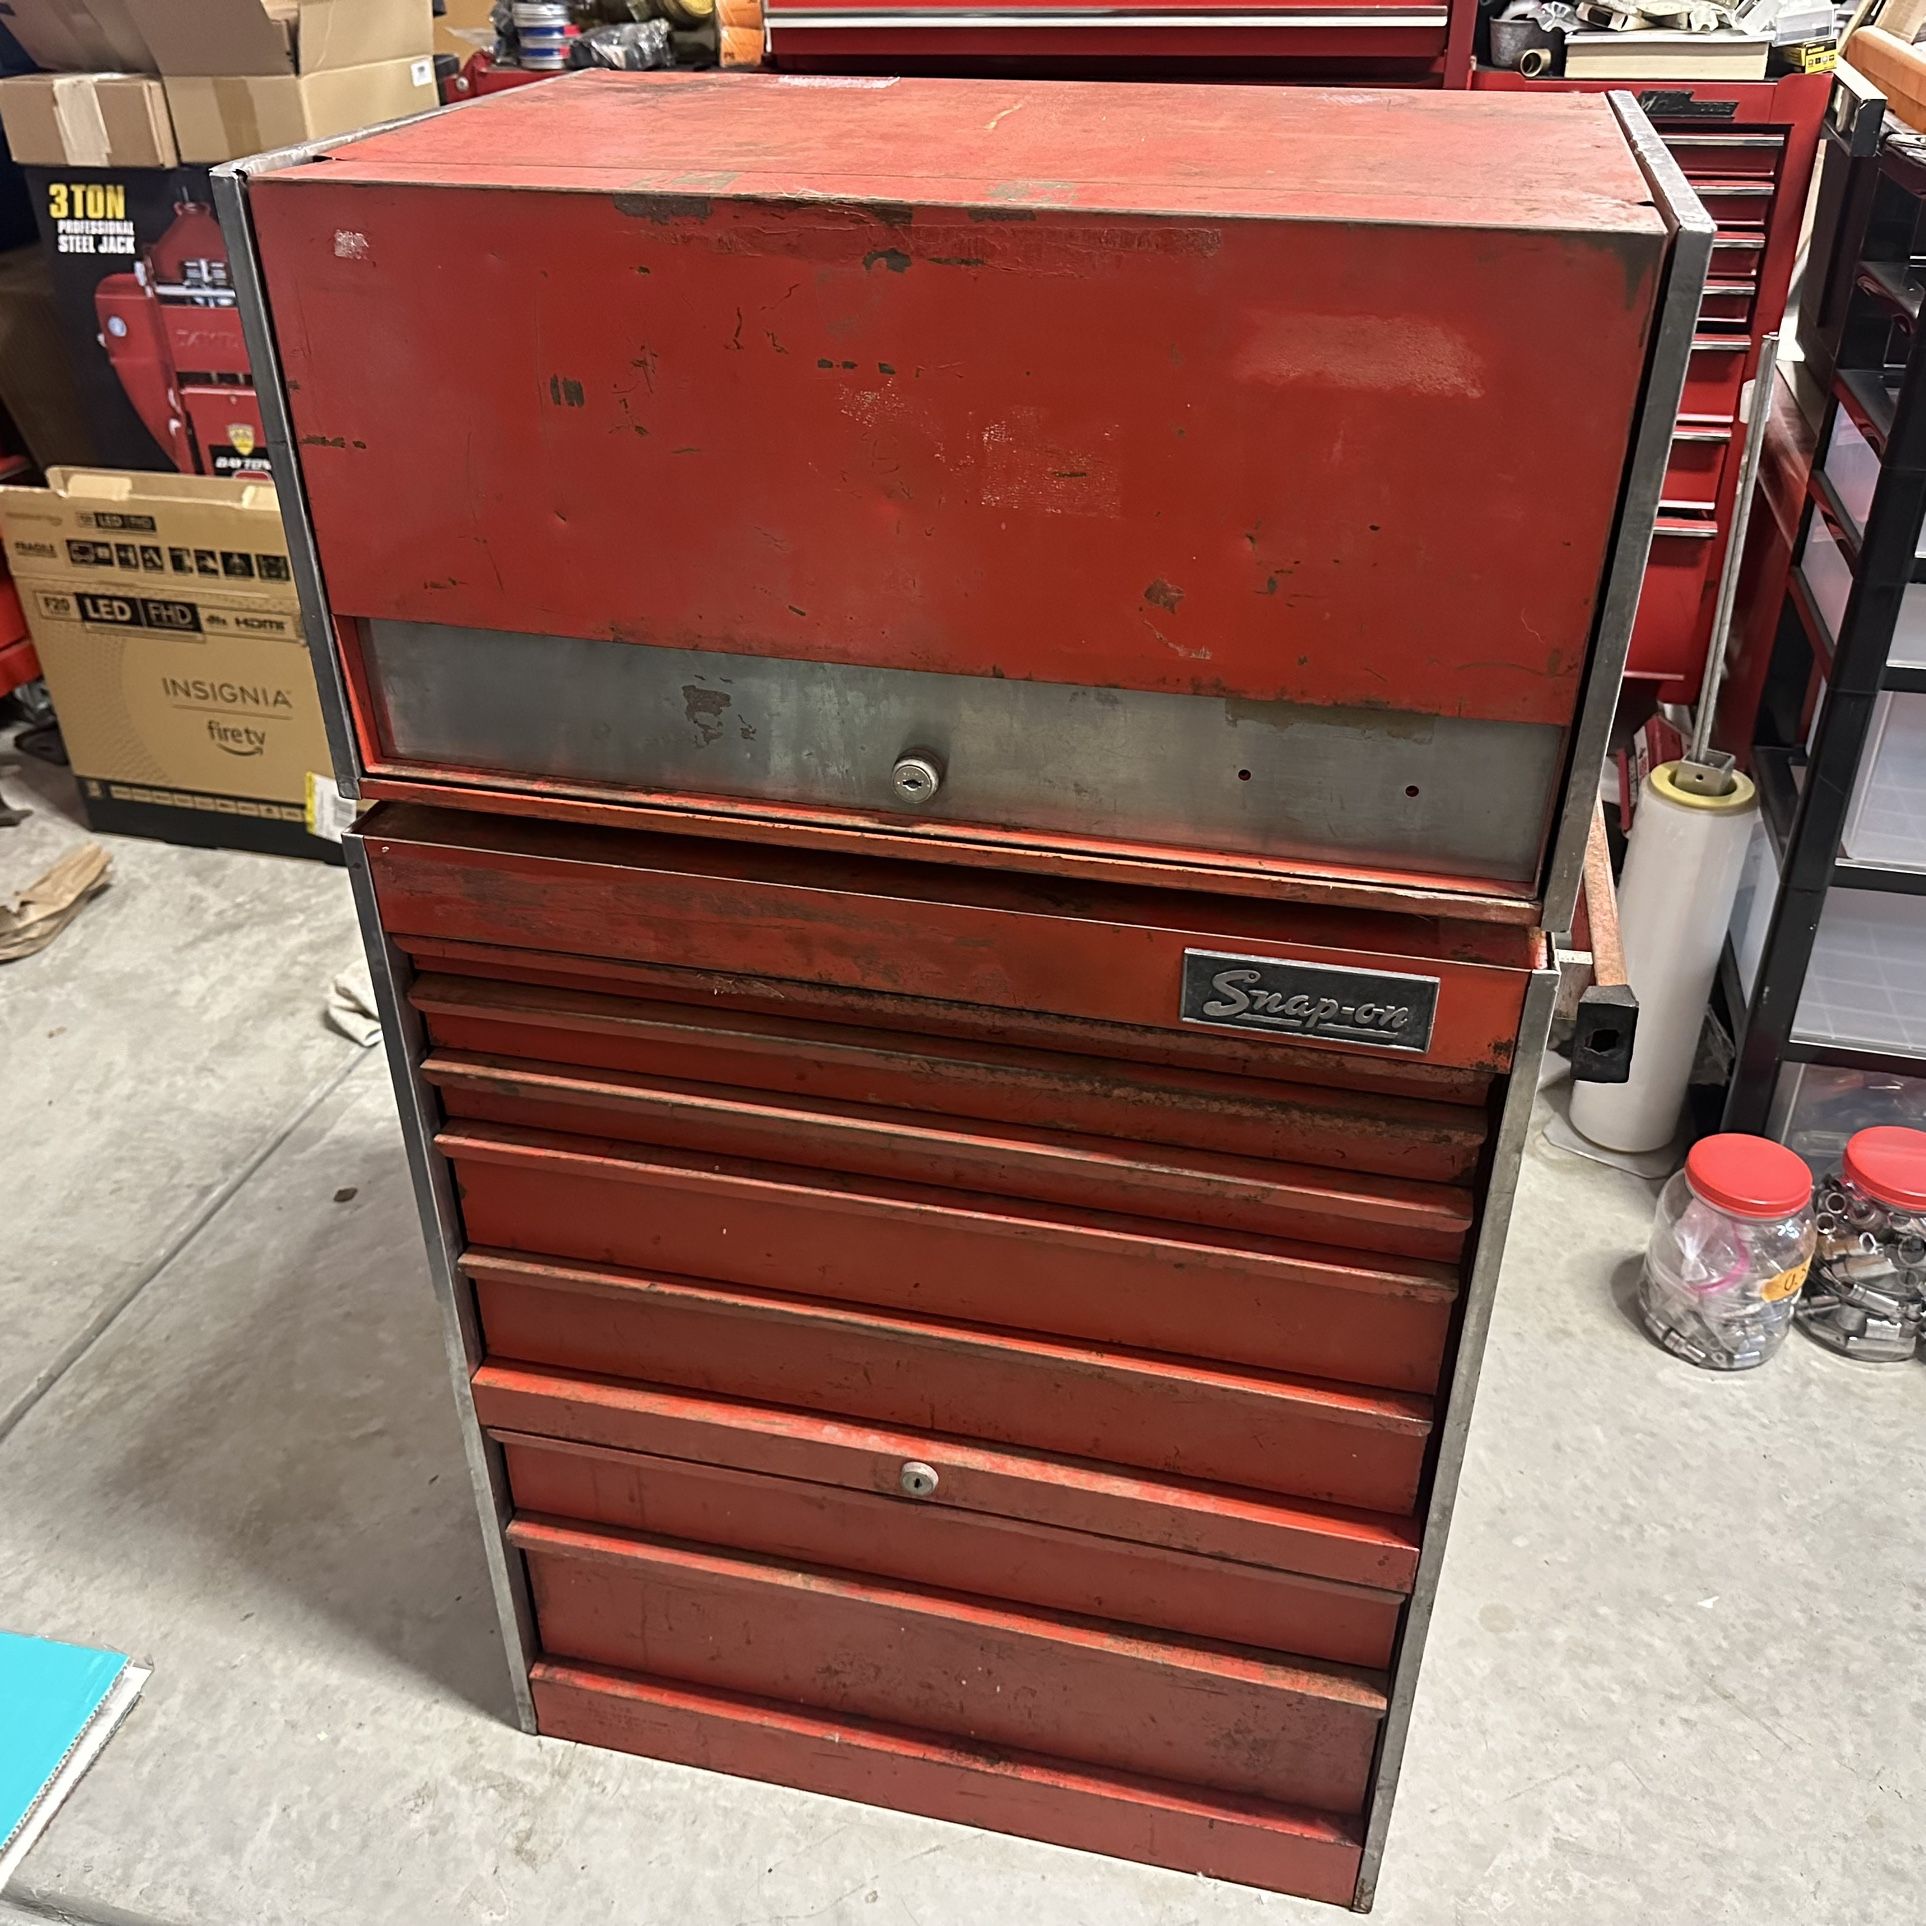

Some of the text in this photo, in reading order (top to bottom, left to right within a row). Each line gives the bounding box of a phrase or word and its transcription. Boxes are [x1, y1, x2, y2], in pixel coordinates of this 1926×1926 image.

[49, 183, 126, 219] 3 TON
[57, 220, 135, 235] PROFESSIONAL
[57, 234, 136, 254] STEEL JACK
[84, 597, 132, 621] LED
[147, 602, 193, 624] FHD
[161, 677, 293, 709] INSIGNIA
[1203, 969, 1409, 1029] Snap-on
